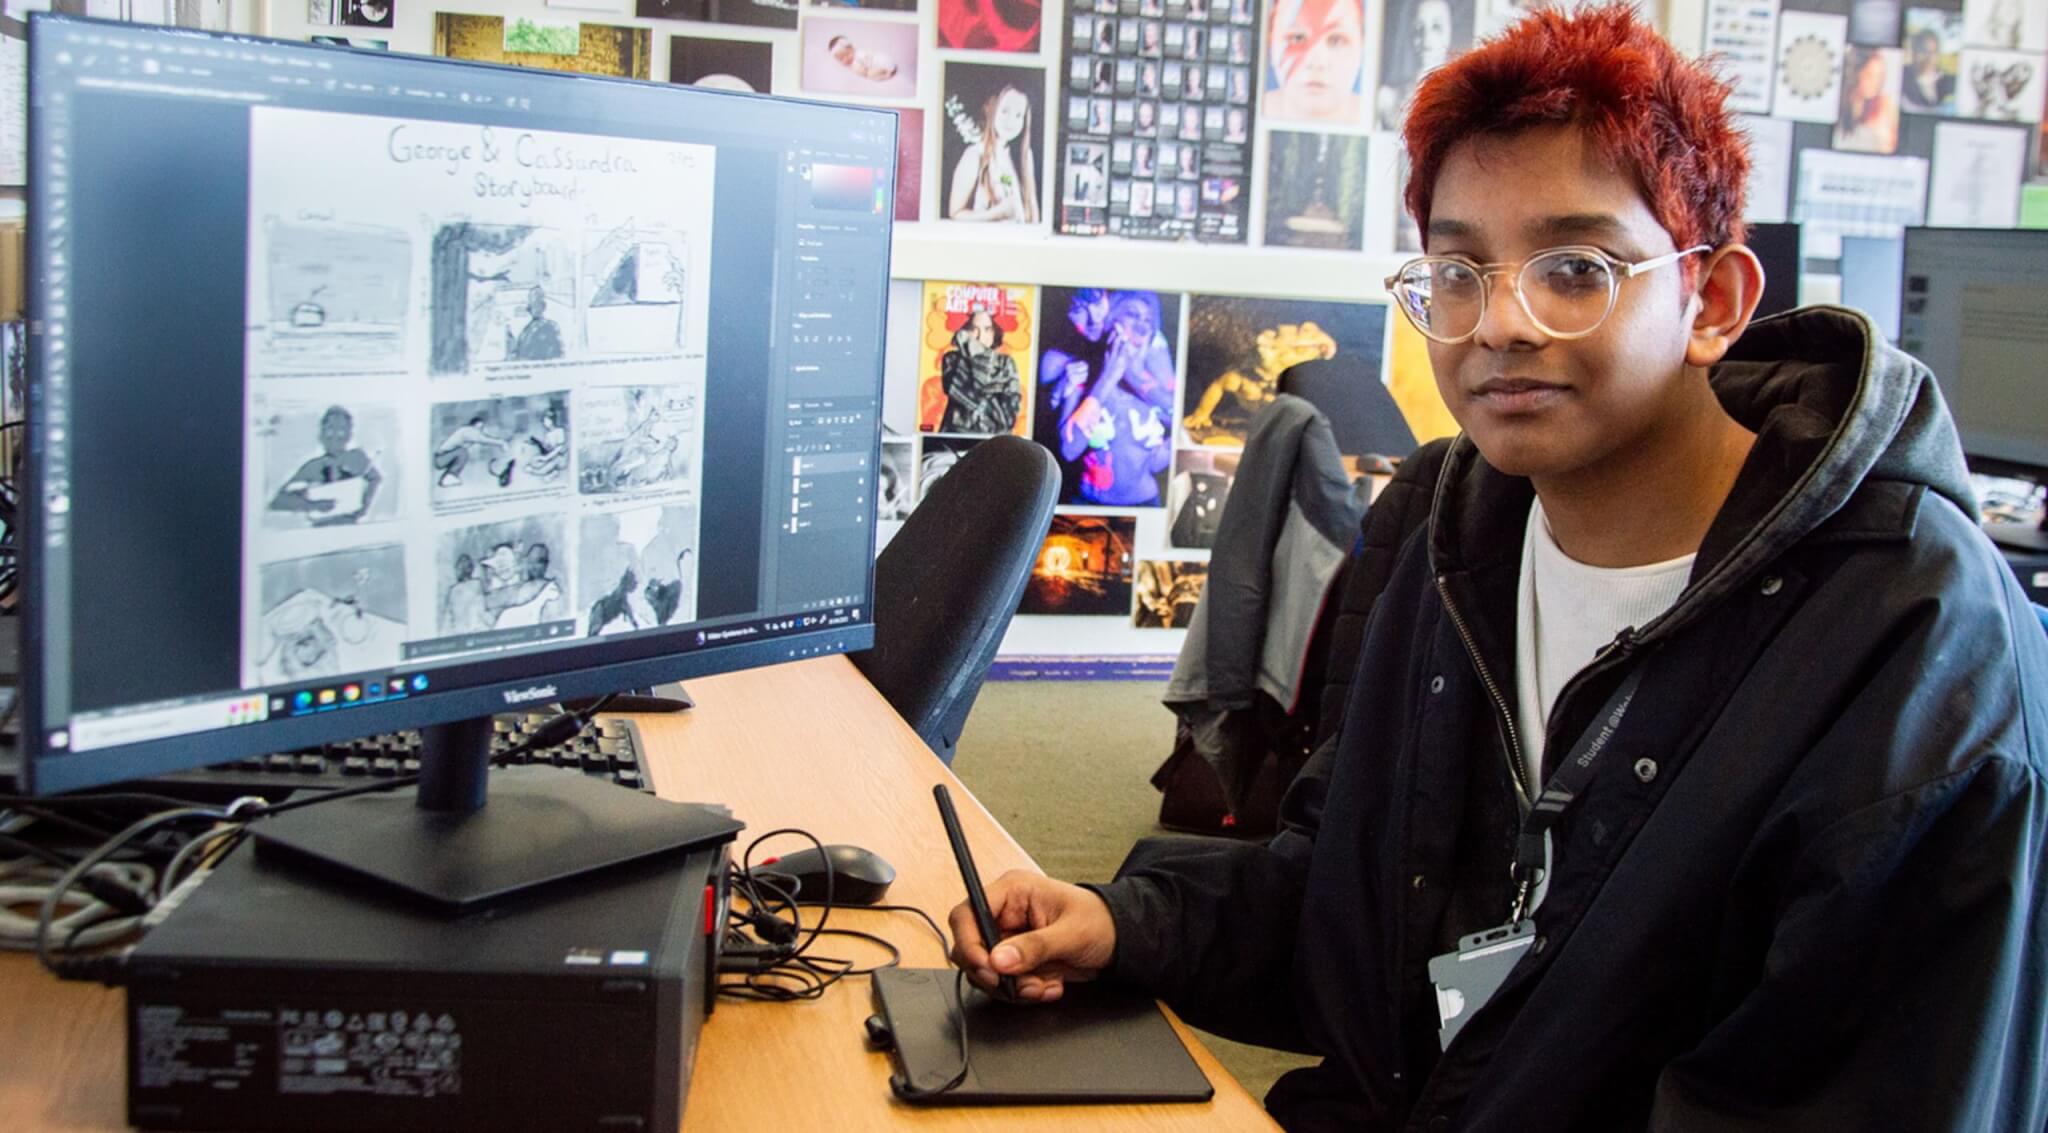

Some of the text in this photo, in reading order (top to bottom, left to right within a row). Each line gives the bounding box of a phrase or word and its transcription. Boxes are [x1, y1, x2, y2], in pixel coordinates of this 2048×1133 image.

[387, 124, 472, 176] George
[481, 125, 500, 163] &
[515, 133, 637, 173] Cassandra
[474, 171, 580, 208] Storyboard
[503, 684, 558, 704] ViewSonic
[1577, 726, 1613, 768] Student
